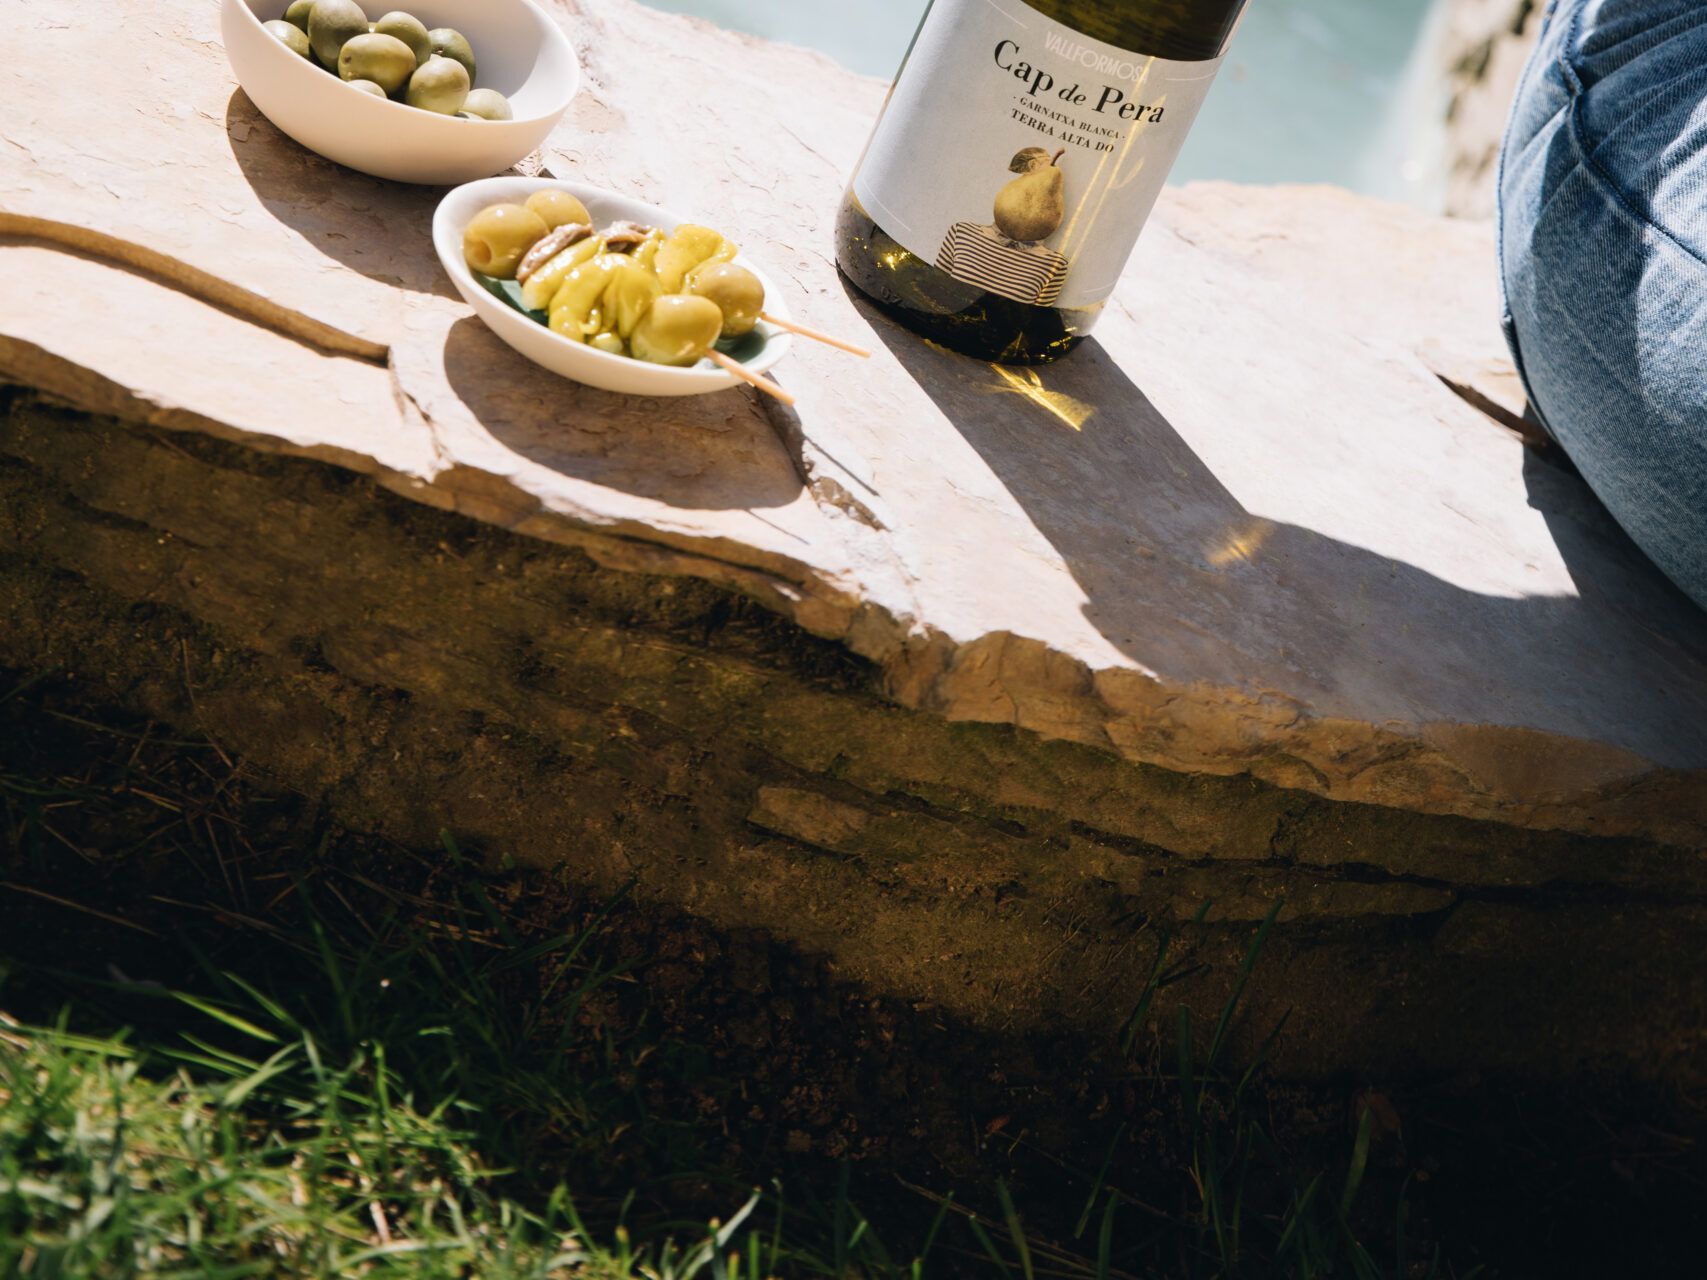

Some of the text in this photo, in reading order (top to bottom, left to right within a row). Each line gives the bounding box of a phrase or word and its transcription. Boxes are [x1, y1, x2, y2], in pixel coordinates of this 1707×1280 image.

[994, 39, 1165, 123] Cap de Pera
[1043, 30, 1151, 84] VALLFORMOSA
[1011, 107, 1114, 154] TERRA ALTA DO
[1020, 96, 1120, 140] GARNATXA BLANCA
